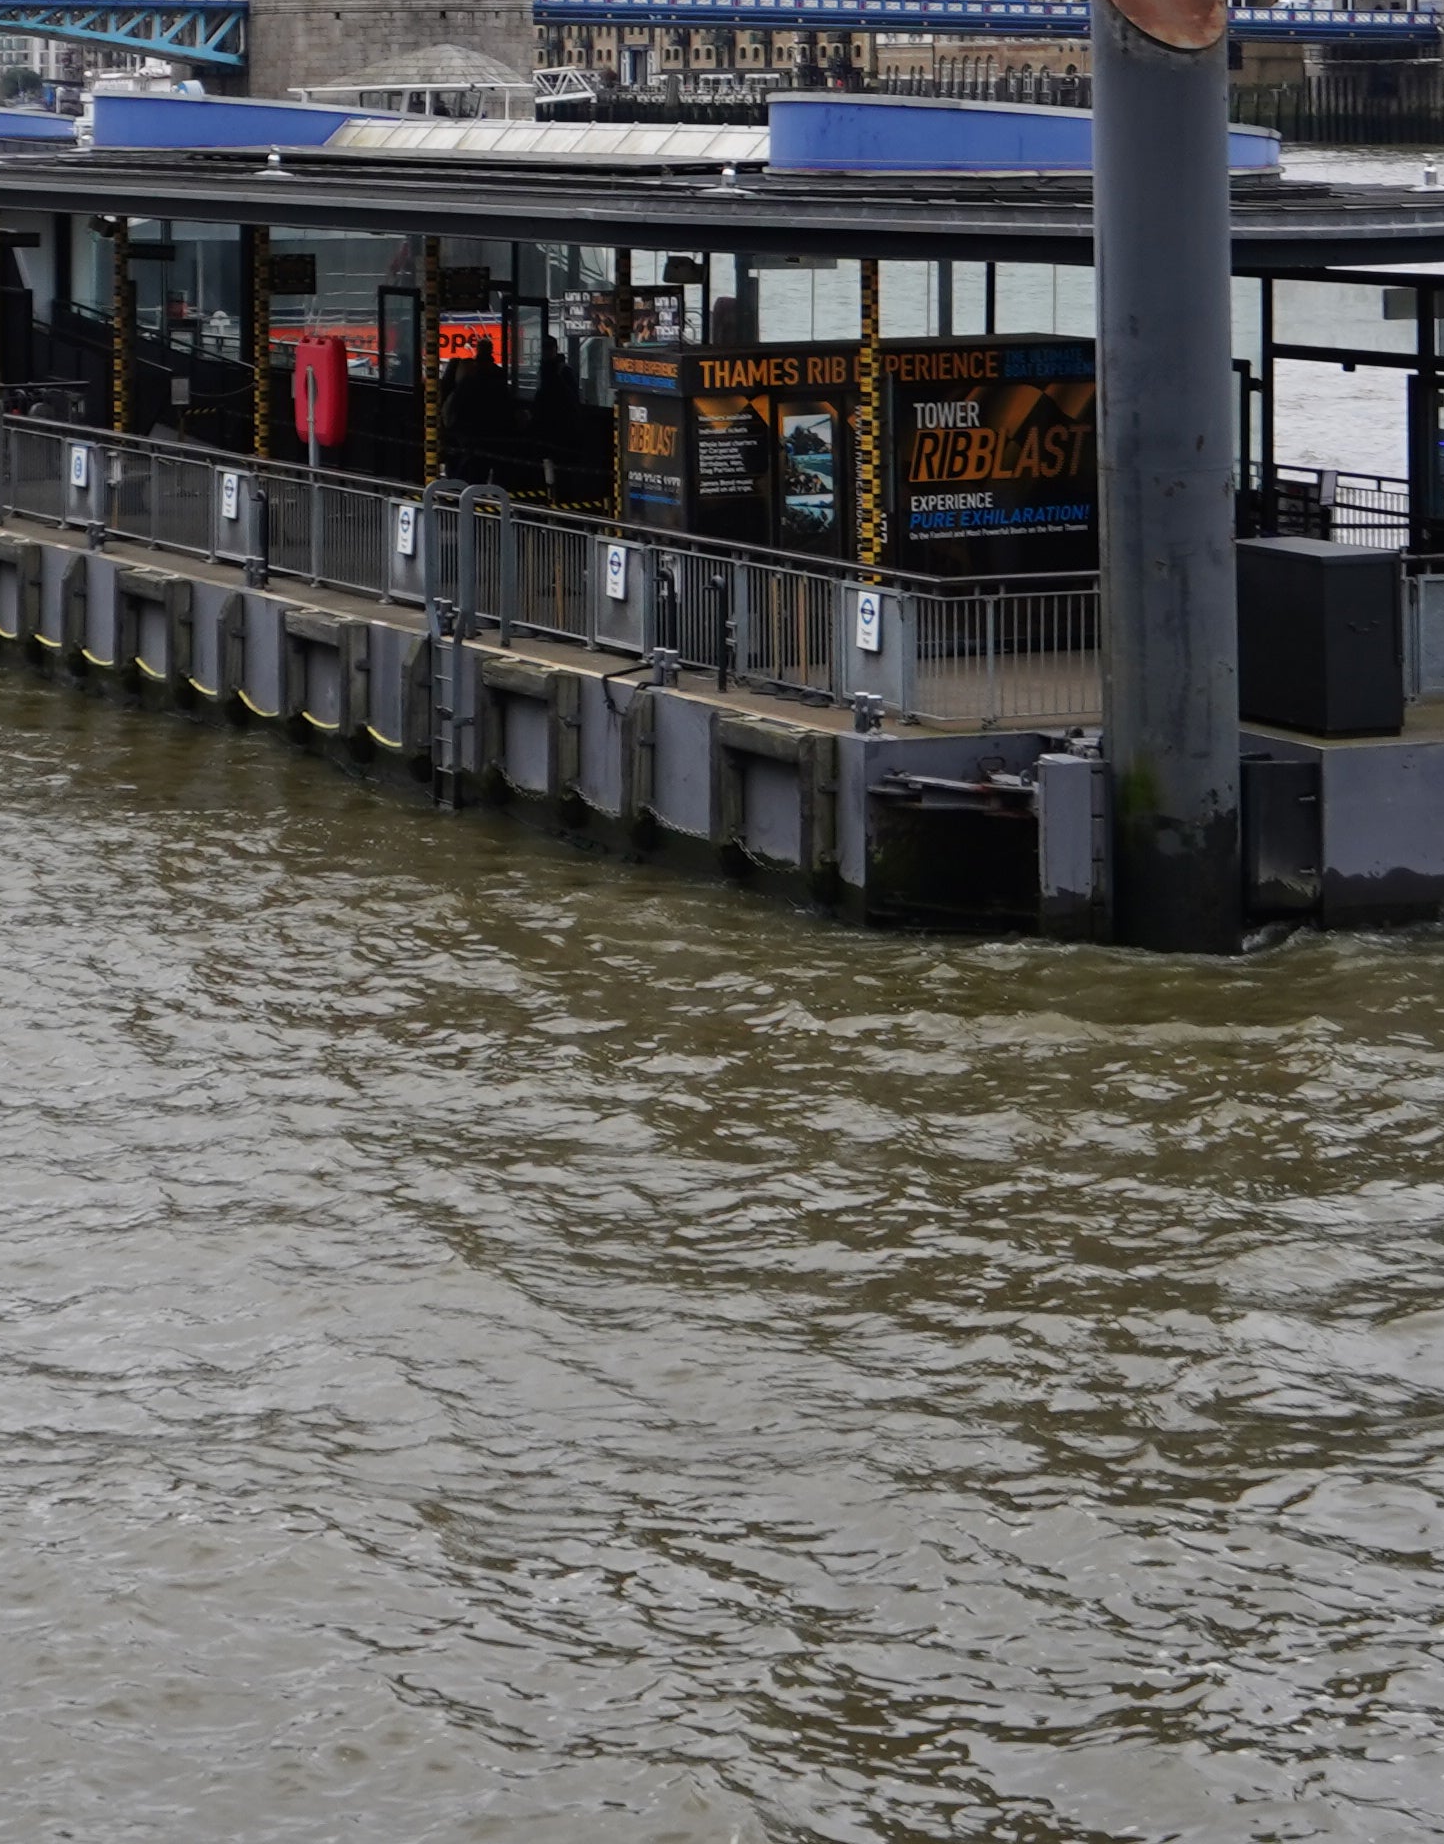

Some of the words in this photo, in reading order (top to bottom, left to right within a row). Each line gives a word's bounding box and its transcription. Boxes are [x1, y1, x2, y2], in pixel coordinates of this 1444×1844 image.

[699, 359, 800, 388] THAMES
[807, 356, 847, 384] RIB
[854, 352, 998, 382] EPERIENCE
[913, 402, 980, 429] TOWER
[628, 422, 678, 456] RIBBLAST
[909, 425, 1091, 482] RIBBLAST
[910, 512, 955, 529] PURE
[960, 505, 1089, 526] EXHILARATION!
[911, 493, 993, 511] EXPERIENCE
